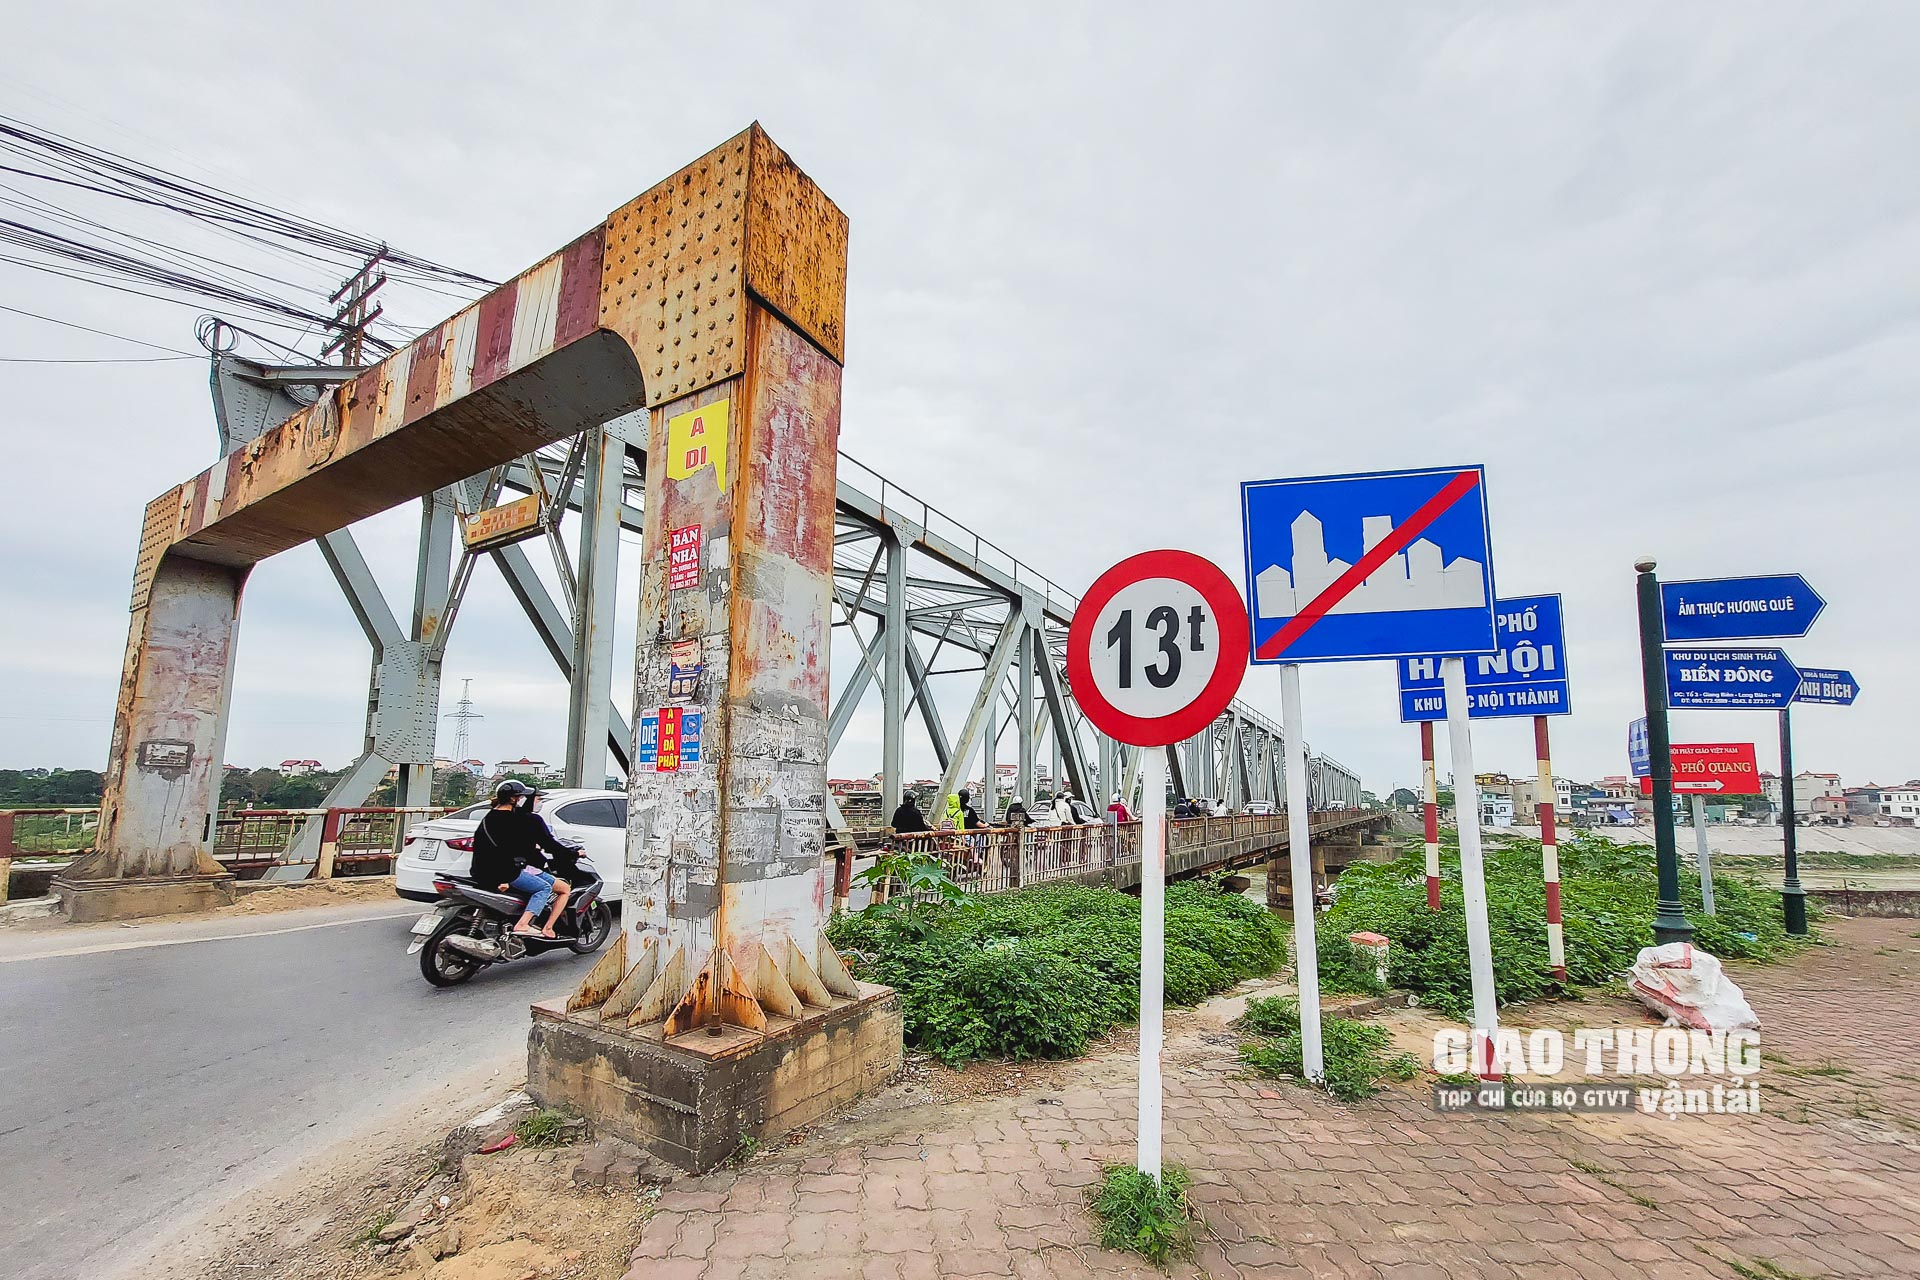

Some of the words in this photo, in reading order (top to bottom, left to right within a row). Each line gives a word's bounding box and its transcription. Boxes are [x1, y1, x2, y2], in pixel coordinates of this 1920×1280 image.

[690, 416, 704, 437] A
[685, 445, 707, 469] DI
[672, 529, 699, 548] BÁN
[672, 544, 698, 565] NHÀ
[1678, 598, 1695, 616] ẨM
[1697, 602, 1725, 617] THỰC
[1727, 599, 1767, 614] HƯƠNG
[1770, 596, 1794, 612] QUÊ
[1498, 605, 1538, 633] PHỐ
[1408, 658, 1445, 681] H
[1478, 640, 1555, 678] NỘI
[1709, 653, 1729, 662] LỊCH
[1755, 651, 1776, 660] THÁI
[1680, 663, 1720, 682] BIỂN
[1724, 666, 1773, 682] ĐÔNG
[1823, 681, 1851, 698] BÍCH
[1414, 697, 1443, 712] KHU
[1478, 691, 1504, 710] NỘI
[1508, 688, 1559, 707] THÀNH
[667, 708, 674, 719] A
[665, 723, 675, 735] DI
[663, 737, 675, 751] ĐÀ
[657, 753, 680, 769] PHẬT
[1708, 762, 1752, 775] QUANG
